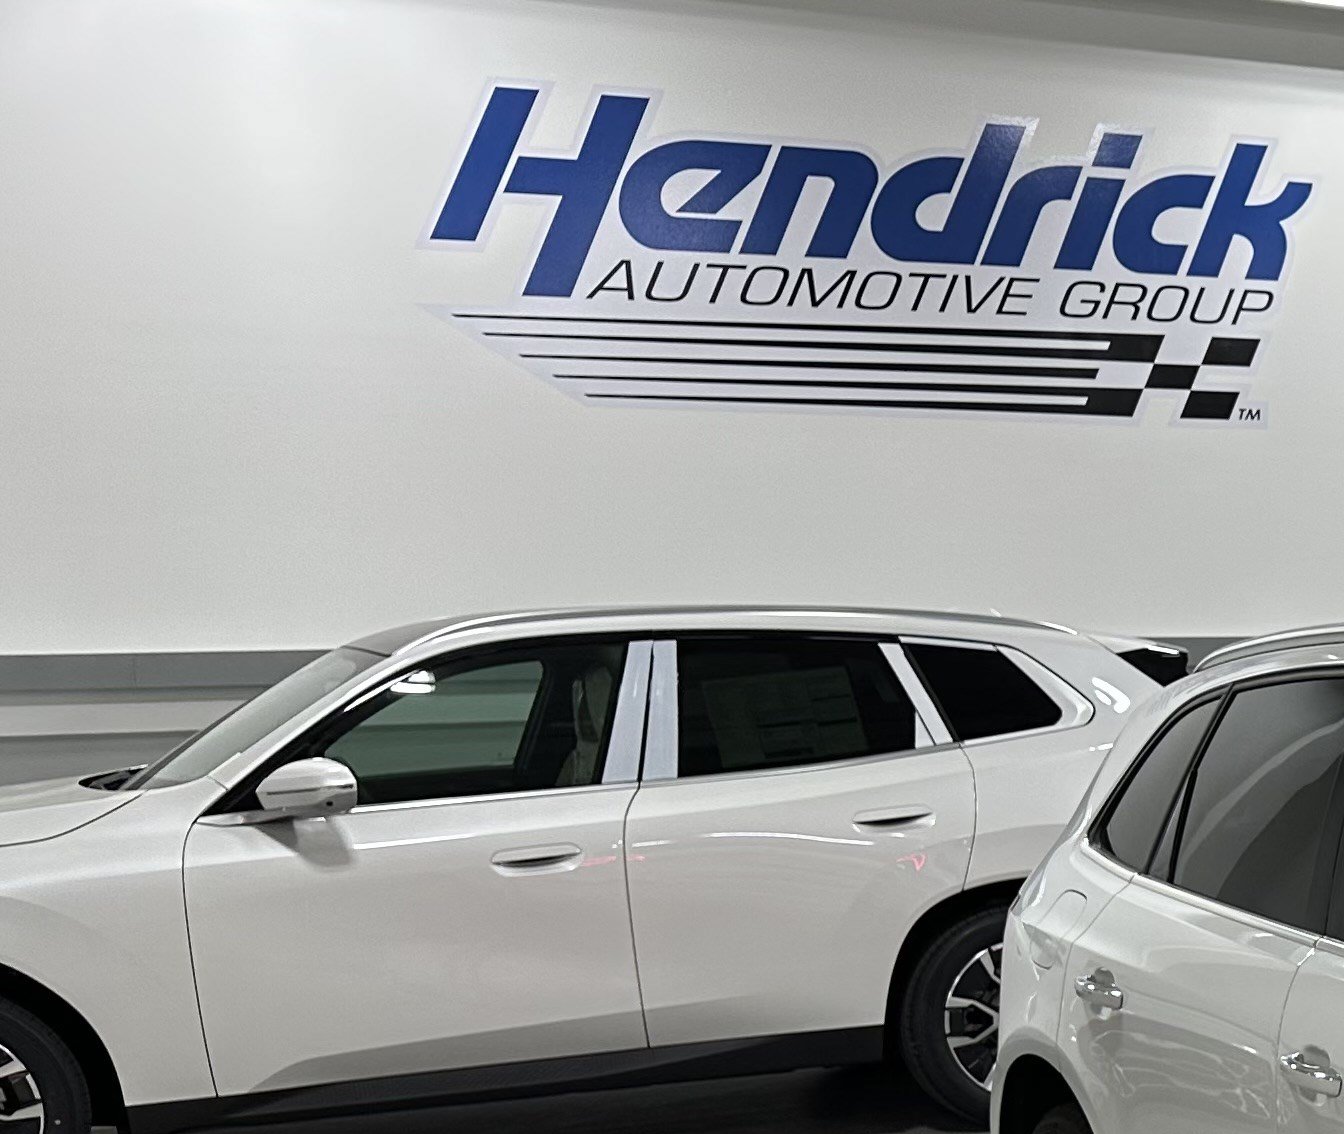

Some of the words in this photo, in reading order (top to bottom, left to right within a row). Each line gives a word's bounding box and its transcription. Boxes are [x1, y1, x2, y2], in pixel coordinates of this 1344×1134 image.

[430, 87, 1314, 297] Hendrick
[587, 259, 1040, 316] AUTOMOTIVE
[1058, 280, 1275, 326] GROUP
[1239, 408, 1261, 421] TM
